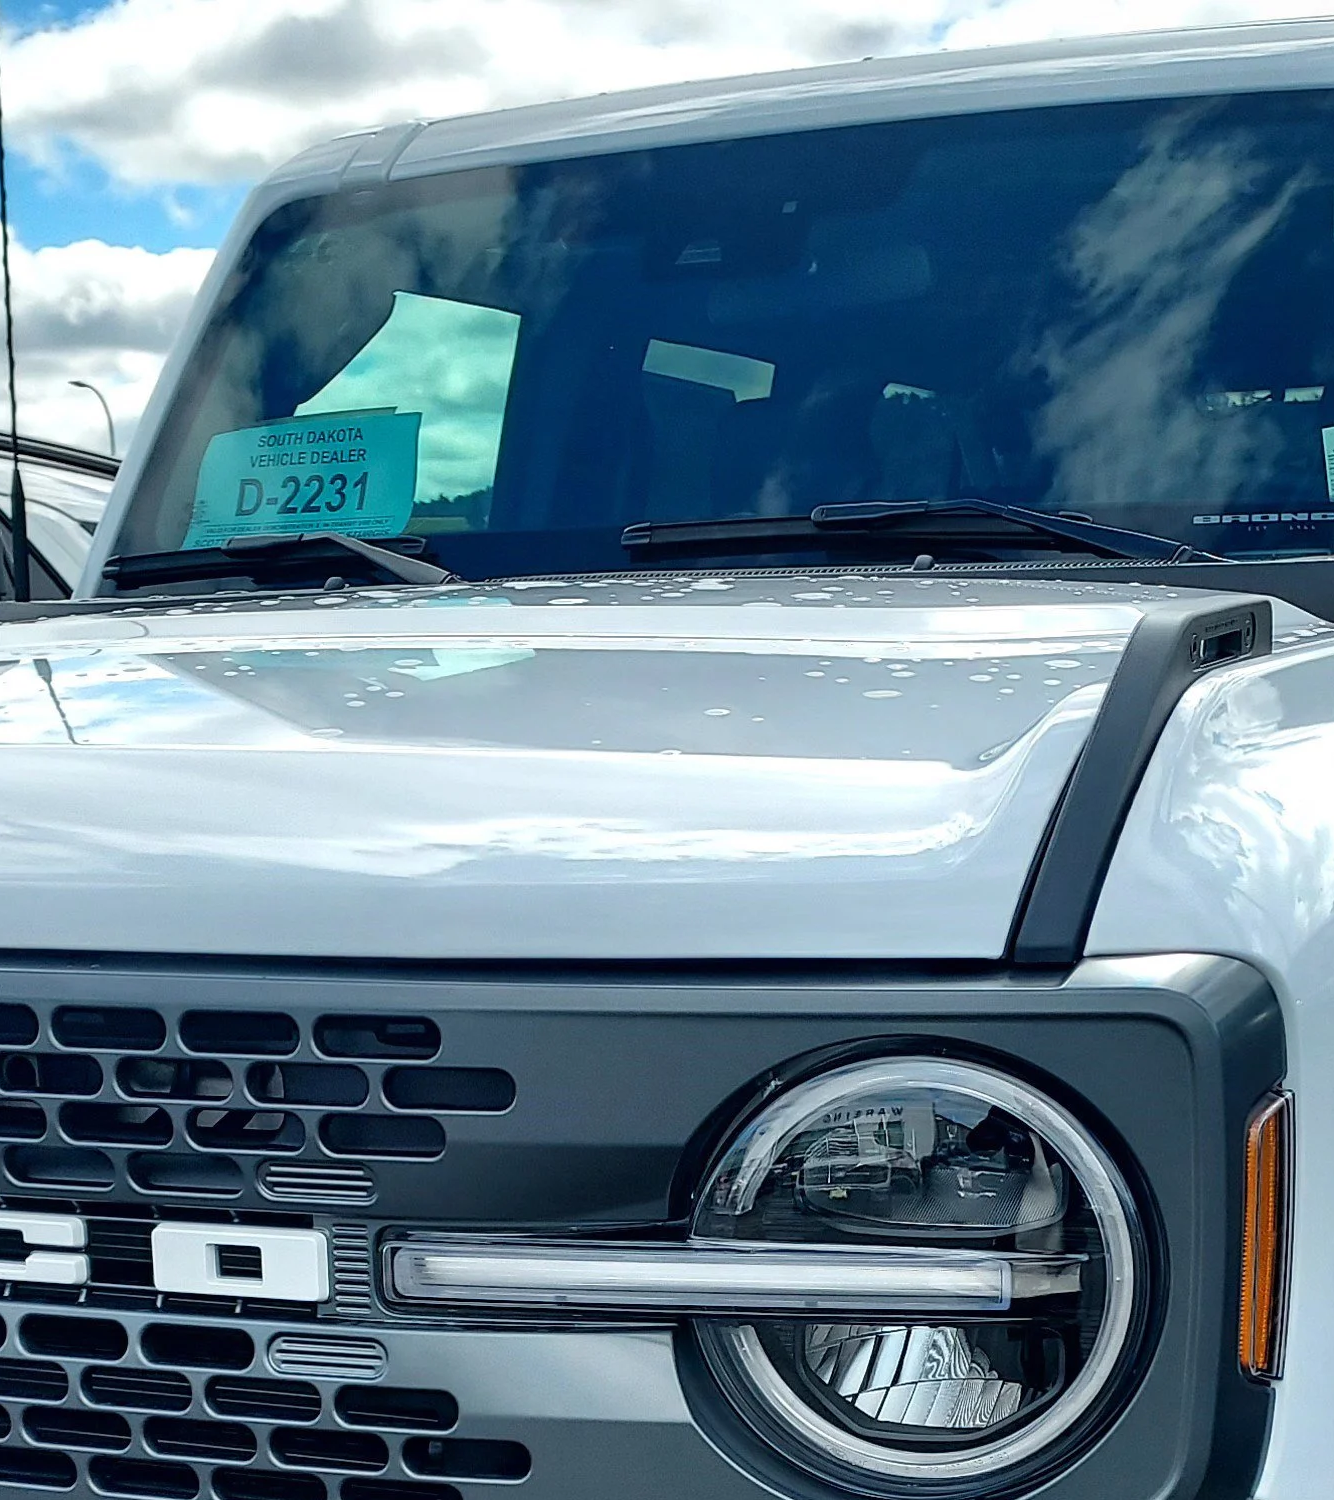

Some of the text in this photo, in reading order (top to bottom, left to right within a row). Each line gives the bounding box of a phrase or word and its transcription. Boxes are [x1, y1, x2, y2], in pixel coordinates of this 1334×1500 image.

[257, 427, 364, 448] SOUTH DAKOTA
[250, 448, 367, 468] VEHICLE DEALER
[234, 471, 369, 517] D-2231
